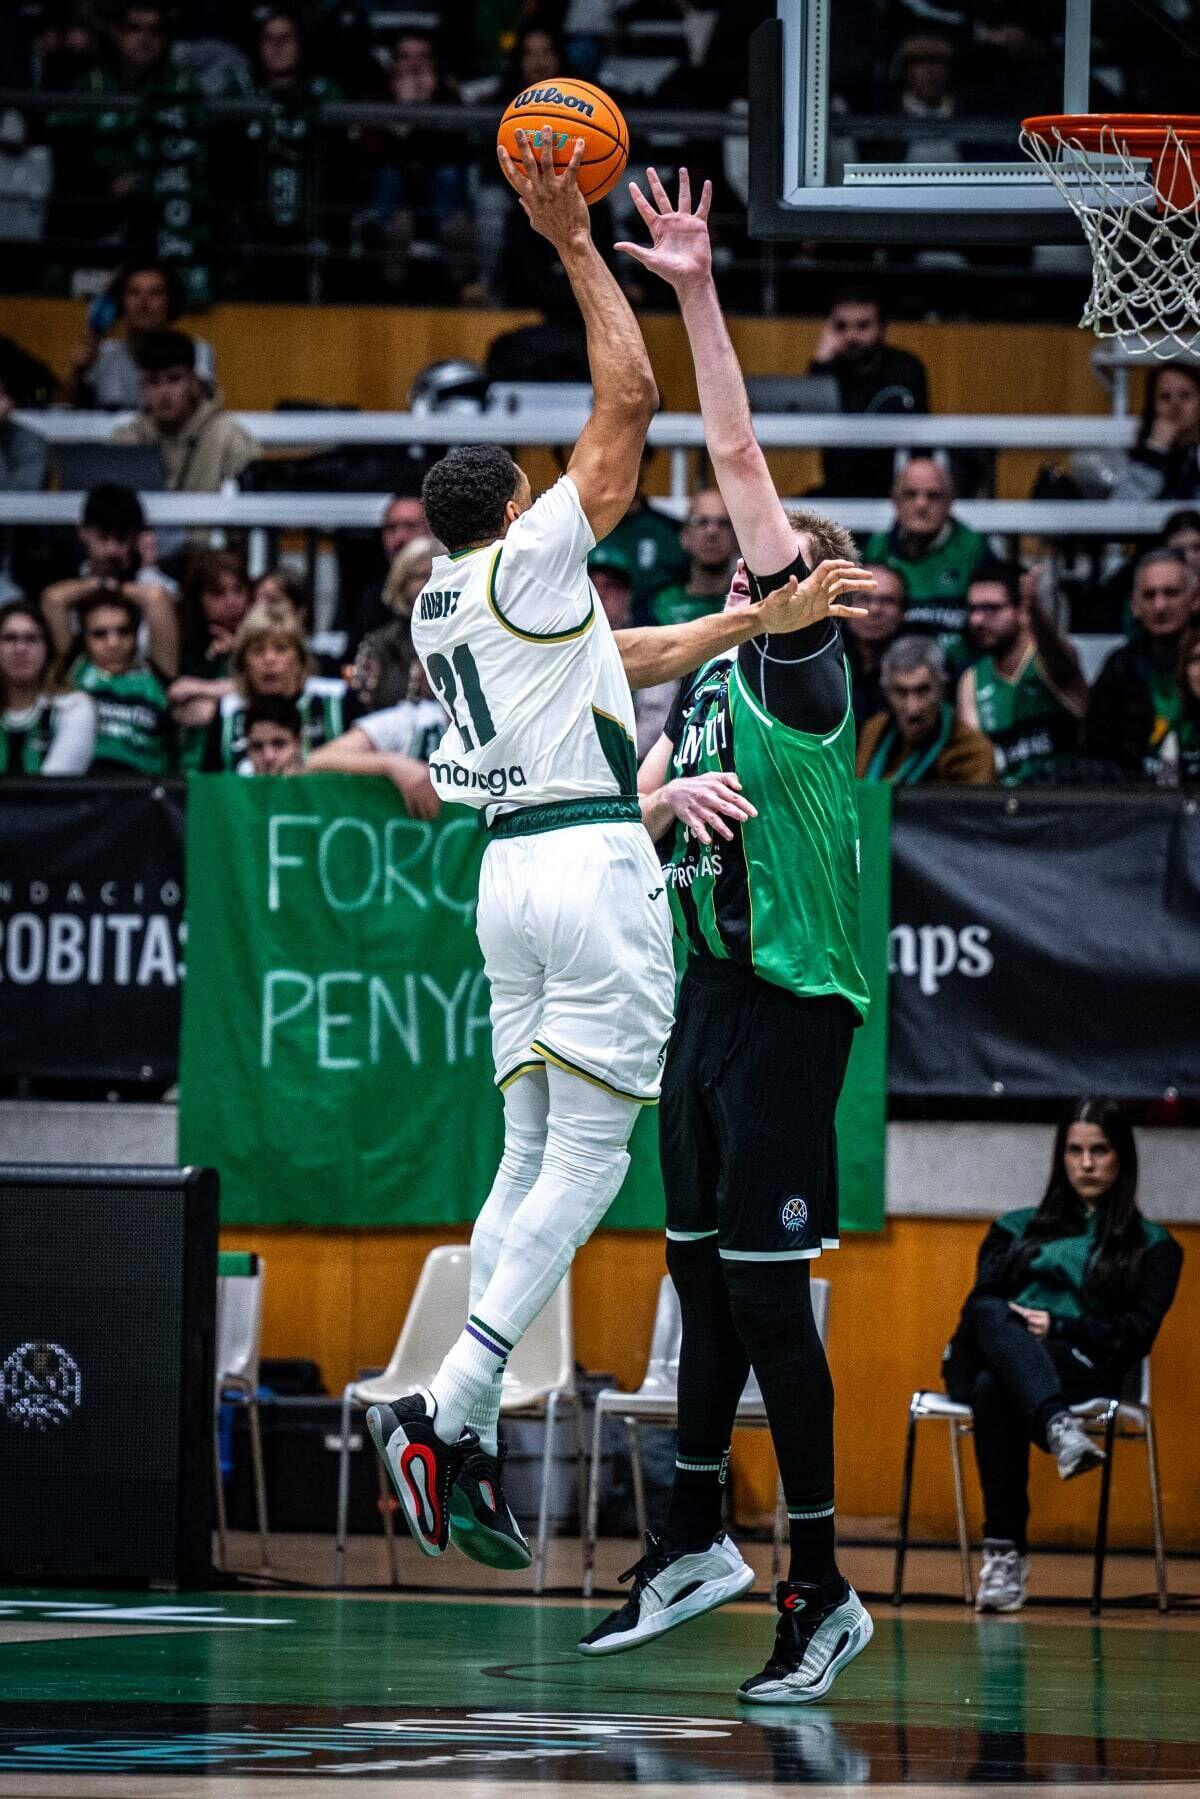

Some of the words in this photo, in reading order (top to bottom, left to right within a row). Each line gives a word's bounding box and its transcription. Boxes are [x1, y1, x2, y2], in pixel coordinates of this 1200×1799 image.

[514, 87, 594, 118] Wilson
[427, 643, 497, 754] 21
[268, 814, 481, 926] FORÇ
[0, 912, 189, 986] OBITA
